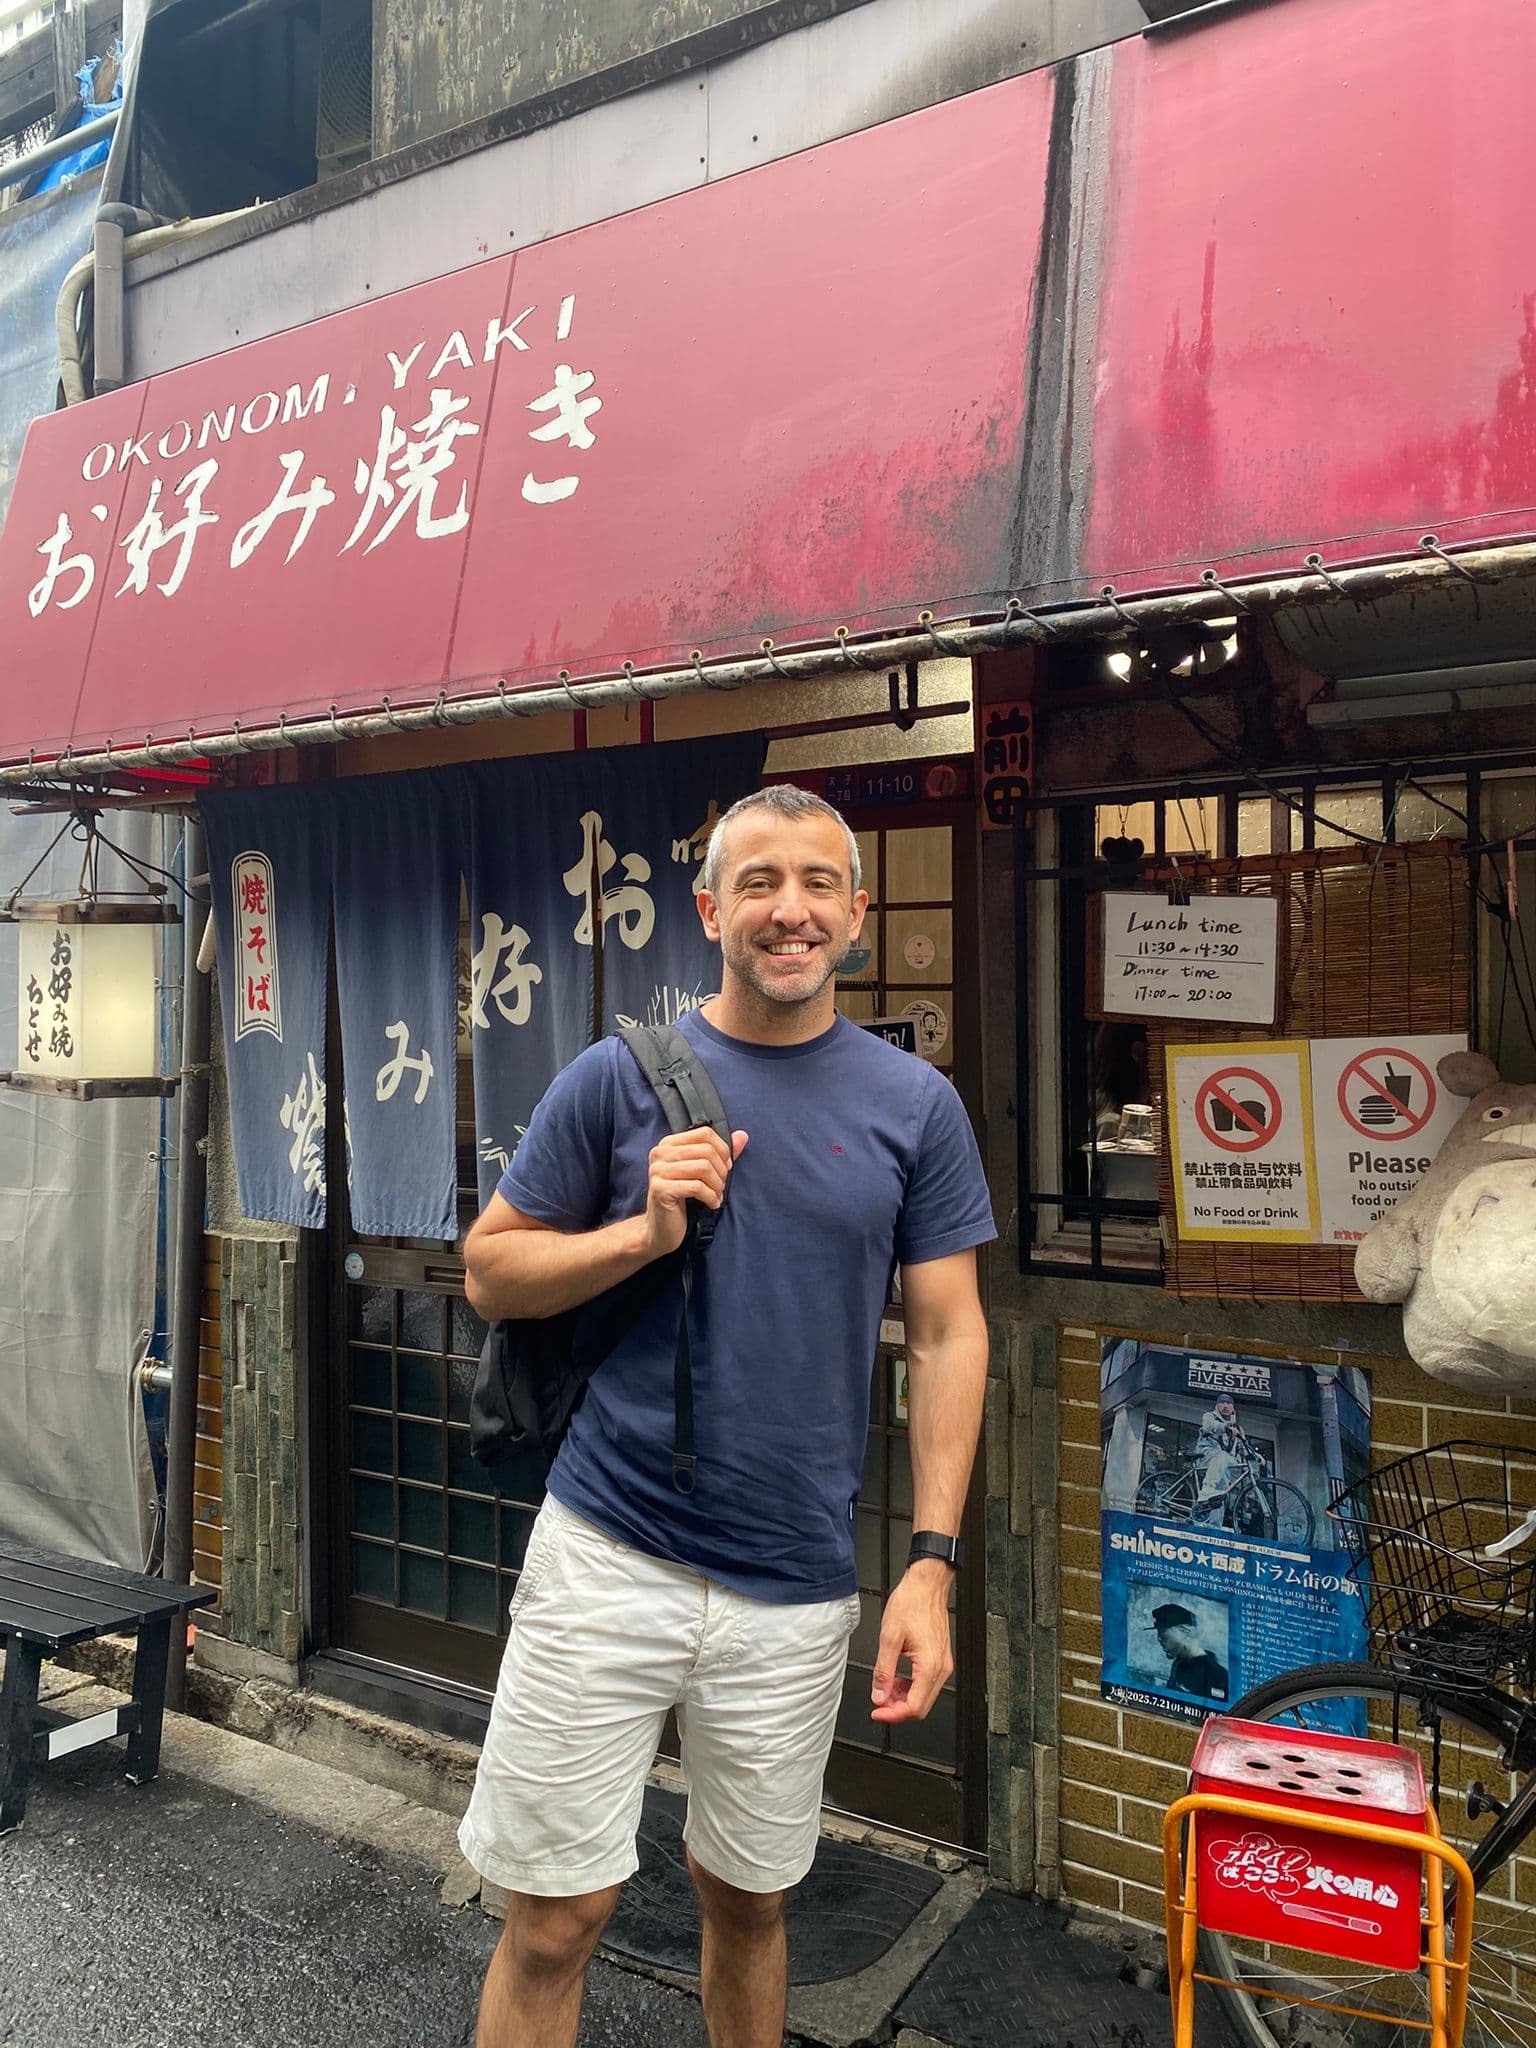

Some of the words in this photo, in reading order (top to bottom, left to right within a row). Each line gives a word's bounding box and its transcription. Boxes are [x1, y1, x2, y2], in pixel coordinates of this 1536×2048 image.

[386, 293, 576, 390] YAKI
[28, 363, 603, 618] お好み焼き
[866, 775, 913, 795] 11-10
[1127, 912, 1188, 933] Lunch
[1198, 917, 1242, 934] time
[241, 873, 271, 1012] 焼そば
[1123, 962, 1169, 976] Dinner
[1181, 966, 1220, 979] time
[48, 928, 74, 1059] お好み焼
[25, 973, 43, 1063] ちとせ
[1184, 1162, 1302, 1177] 禁止带食品与饮料
[1349, 1151, 1432, 1173] Please
[1359, 1180, 1376, 1191] No
[1352, 1194, 1381, 1206] food
[1384, 1198, 1397, 1206] or
[1194, 1206, 1211, 1216] No
[1214, 1206, 1244, 1217] Food
[1248, 1208, 1261, 1217] or
[1264, 1207, 1299, 1218] Drink
[1188, 1369, 1271, 1391] FIVESTAR
